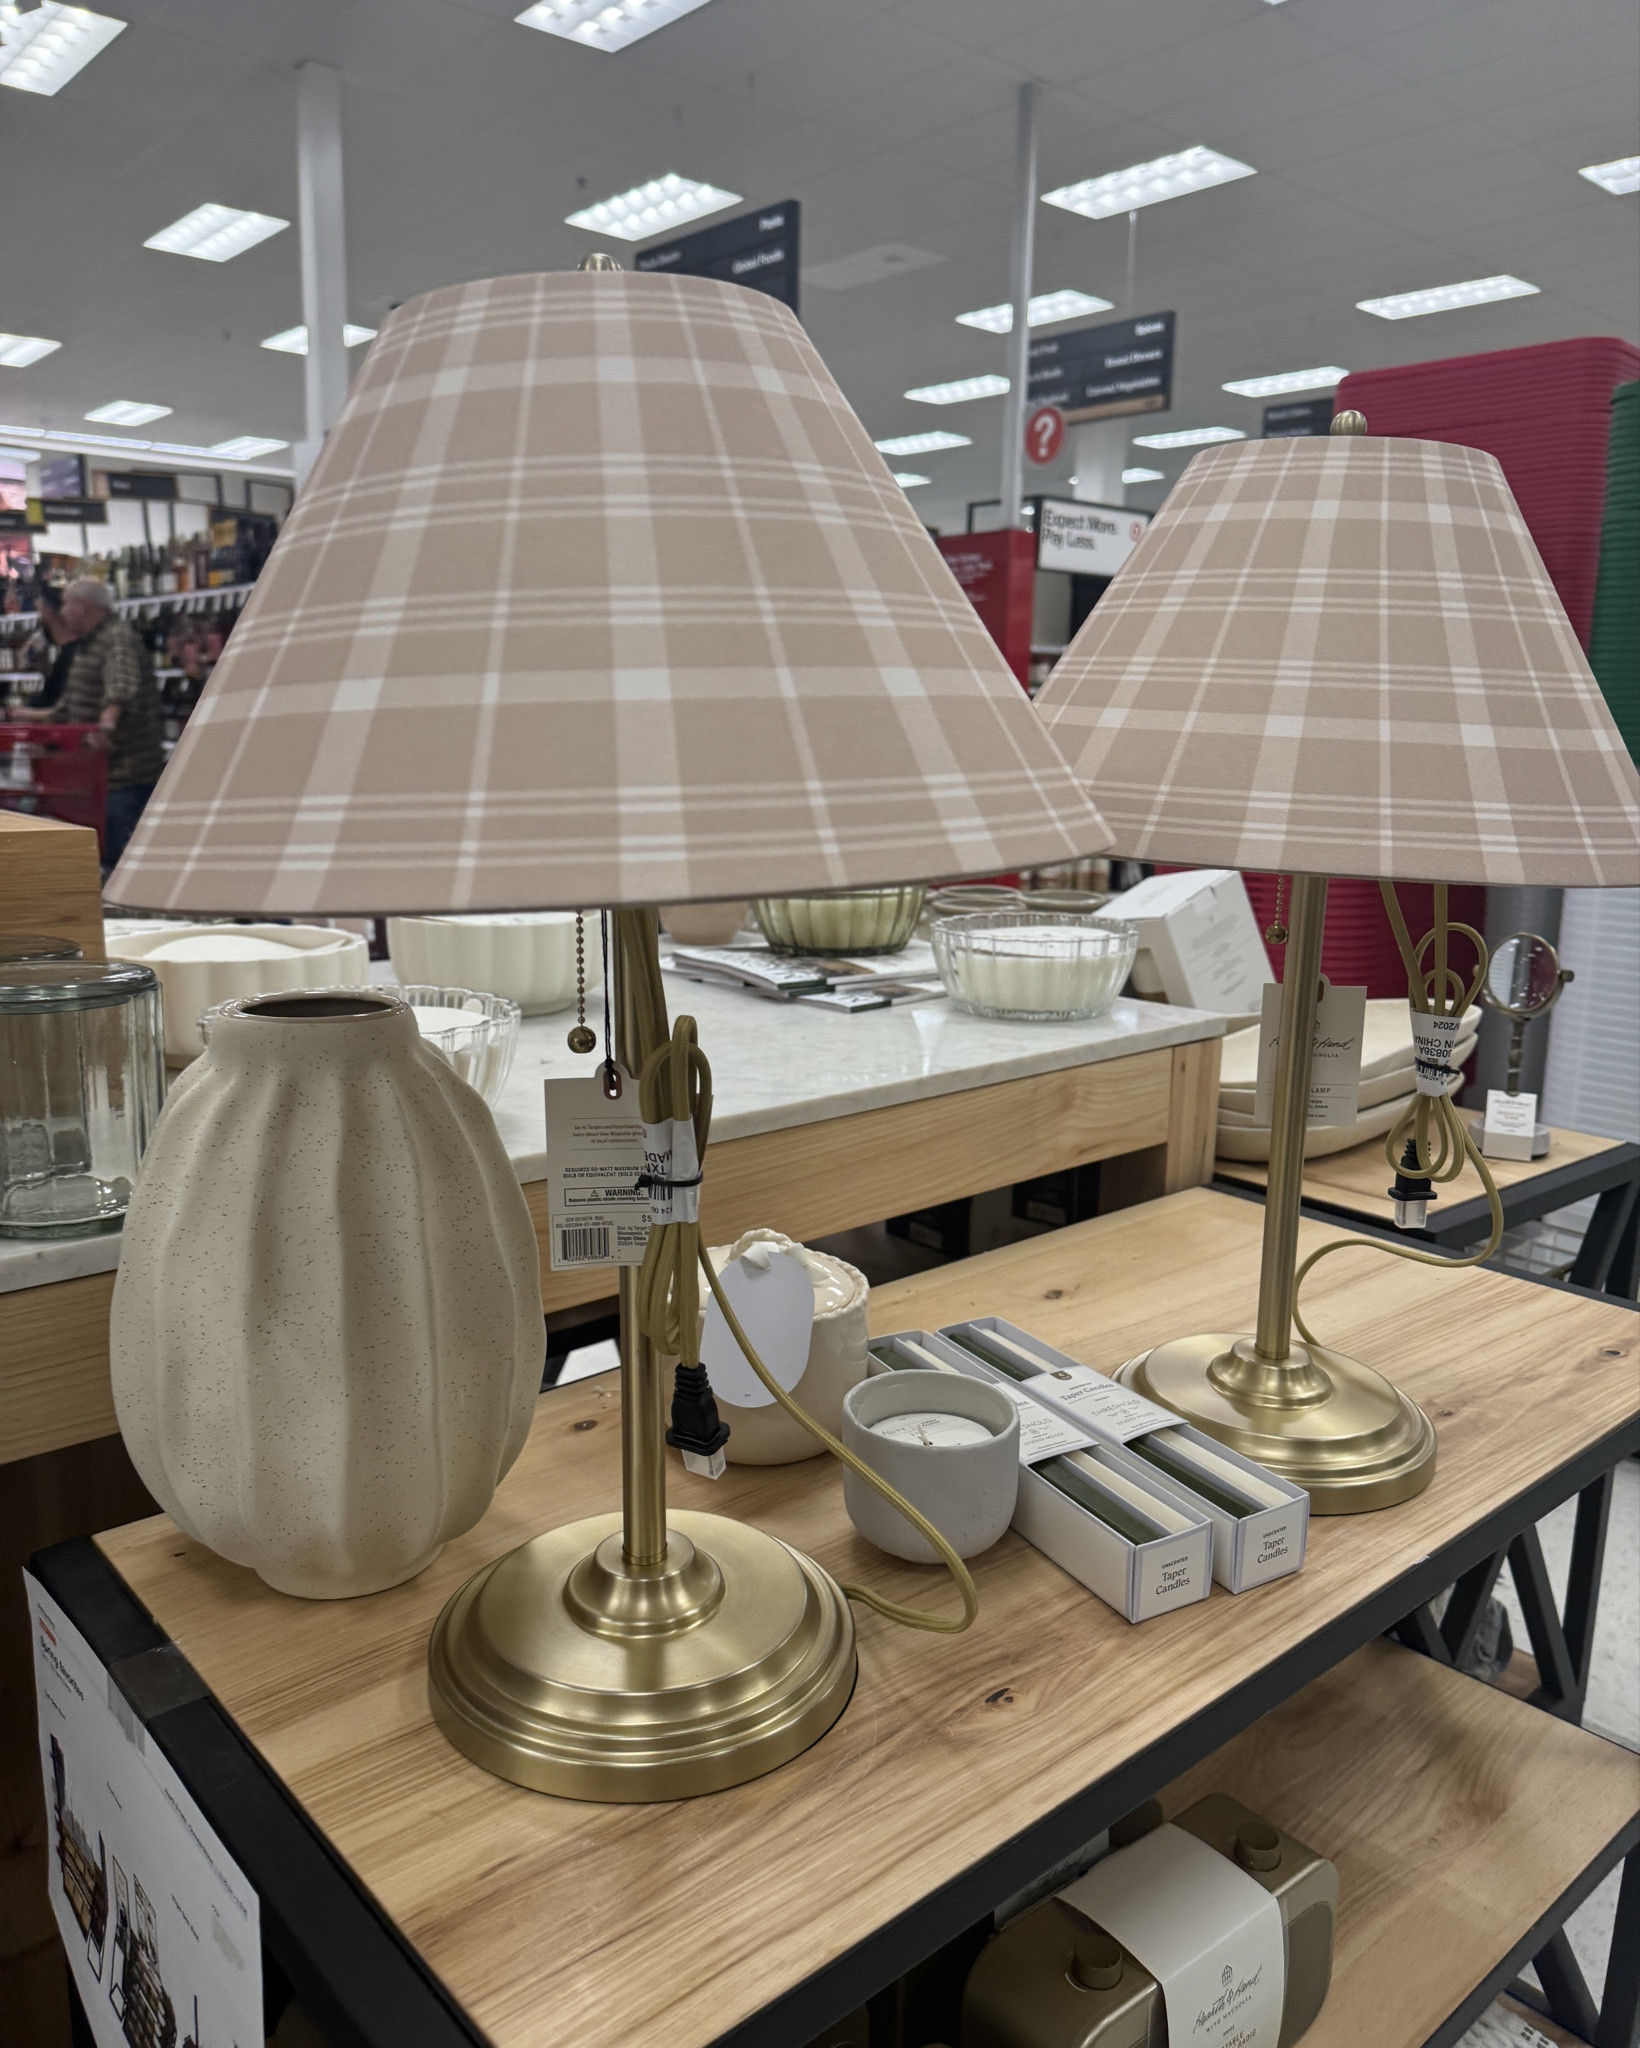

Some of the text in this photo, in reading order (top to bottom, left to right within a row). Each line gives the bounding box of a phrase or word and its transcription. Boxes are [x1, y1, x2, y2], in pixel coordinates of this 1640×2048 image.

[605, 1188, 644, 1197] WARNING:
[1060, 1389, 1083, 1401] Taper
[1263, 1536, 1285, 1551] Taper
[1161, 1556, 1189, 1569] UNSCENTED
[1257, 1546, 1288, 1564] Candles
[1162, 1567, 1187, 1582] Taper
[1155, 1577, 1190, 1595] Candles
